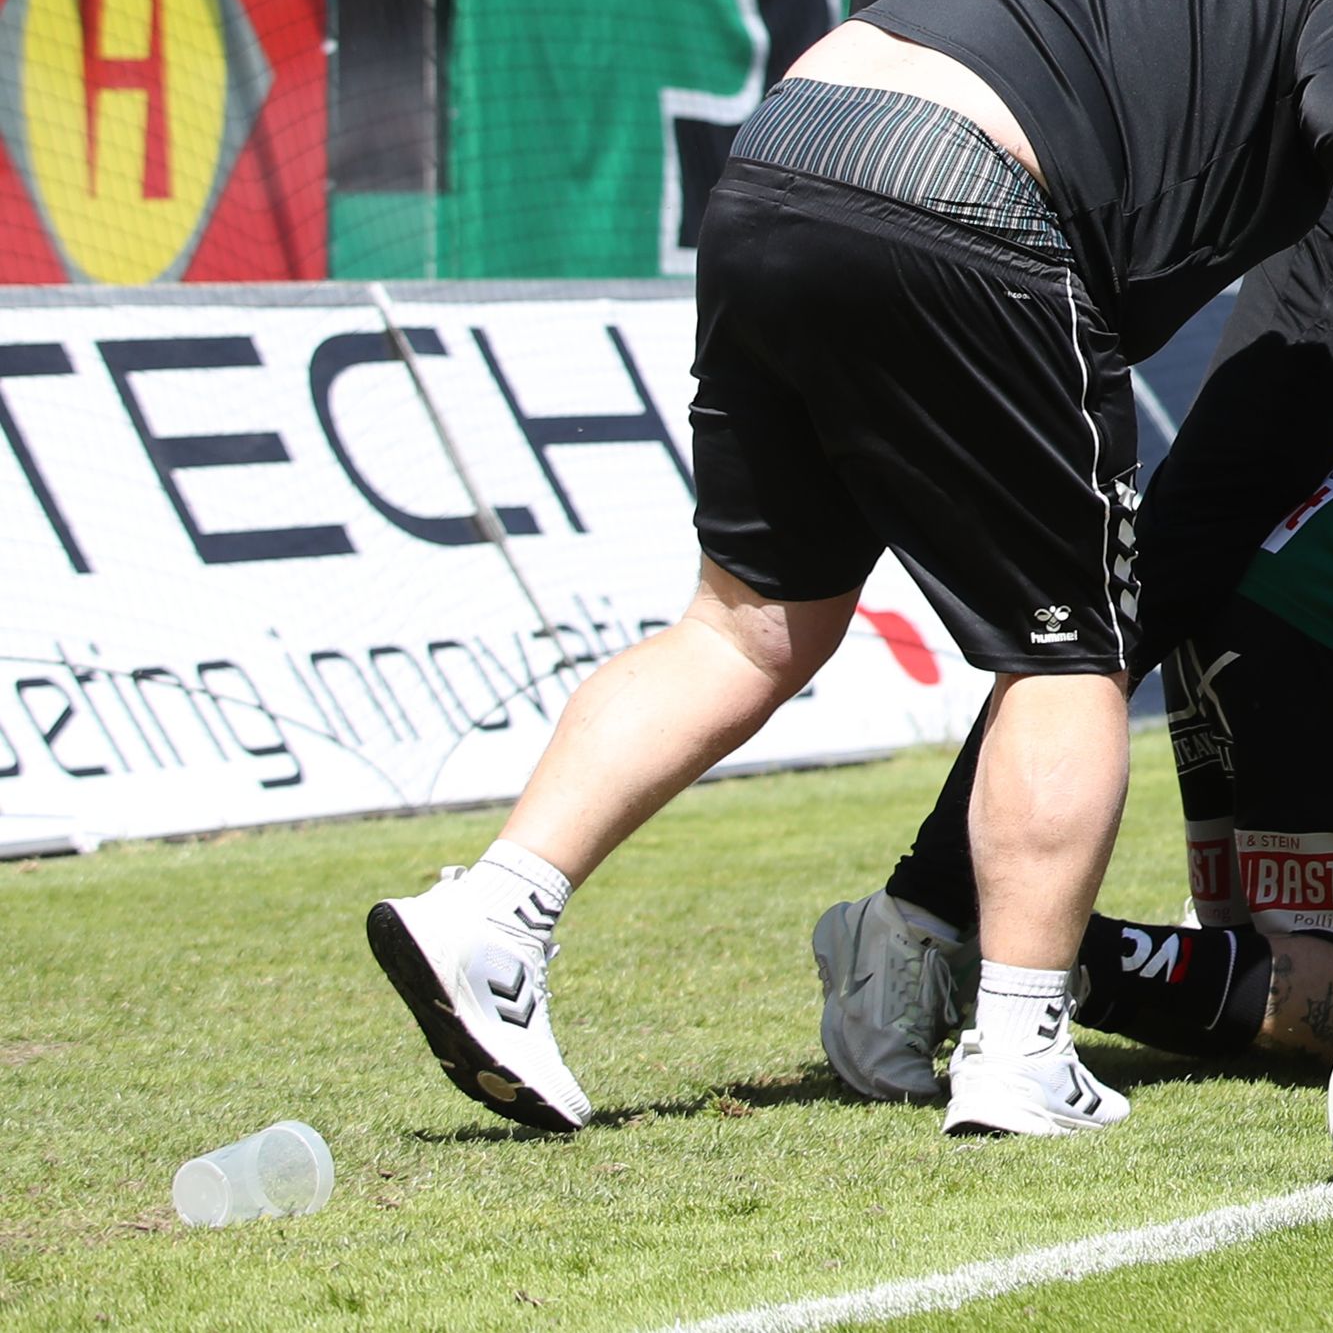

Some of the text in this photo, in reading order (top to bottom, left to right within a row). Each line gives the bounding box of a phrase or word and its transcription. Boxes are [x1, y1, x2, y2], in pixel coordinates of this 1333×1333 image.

[0, 325, 700, 574] TECH
[1030, 629, 1079, 644] hummel
[1259, 834, 1301, 851] STEIN
